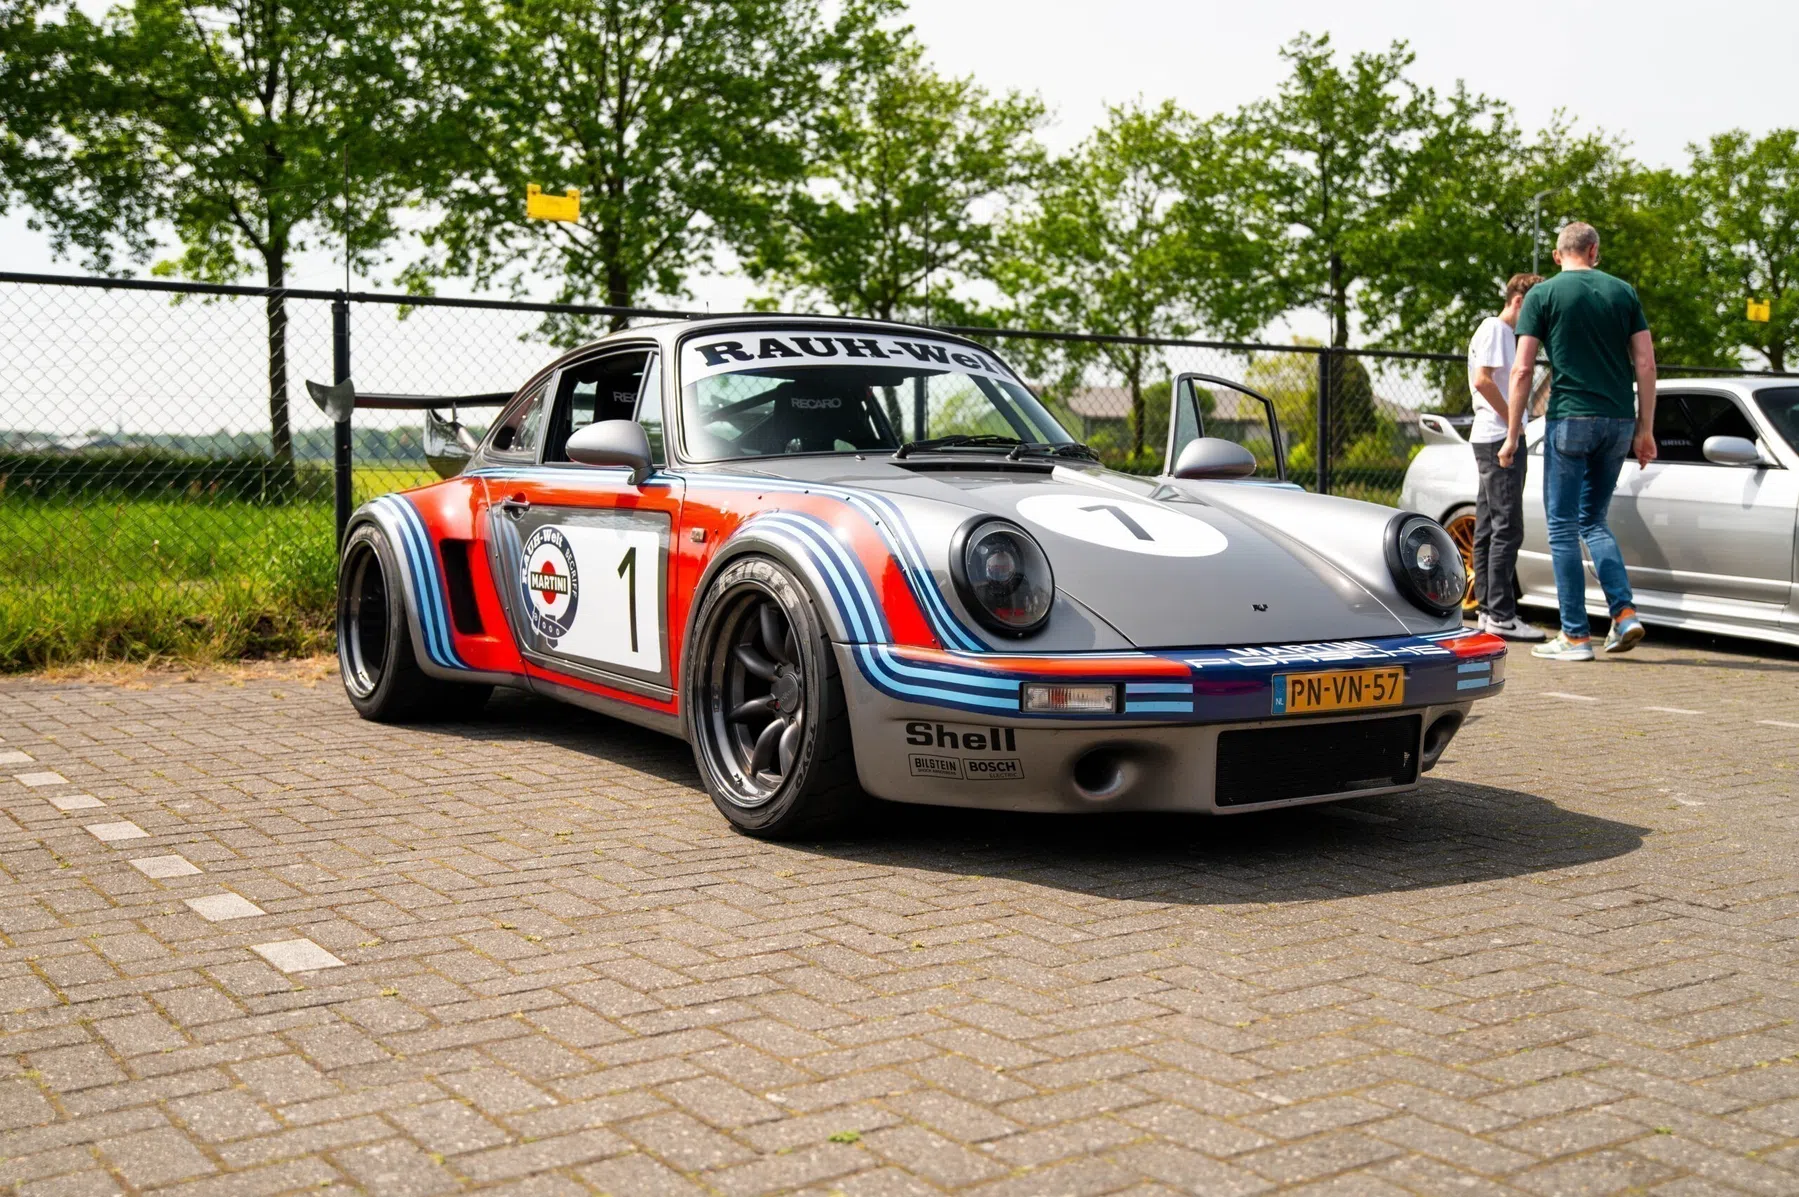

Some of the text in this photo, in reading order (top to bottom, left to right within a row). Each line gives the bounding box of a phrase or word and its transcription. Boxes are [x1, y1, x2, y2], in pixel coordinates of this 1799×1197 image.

[791, 398, 842, 409] RECARO
[1077, 504, 1156, 542] 1
[521, 528, 578, 599] RAUH-Welt BEGRIFF
[531, 573, 567, 592] MARTINI
[617, 546, 639, 653] 1
[1184, 644, 1451, 669] PORSCHE
[1226, 640, 1379, 657] MARTINI
[1275, 698, 1284, 706] NL
[1291, 672, 1400, 707] PN-VN-57
[906, 722, 1016, 751] Shell
[795, 723, 817, 790] TOYO
[914, 758, 957, 771] BILSTEIN
[969, 761, 1017, 772] BOSCH
